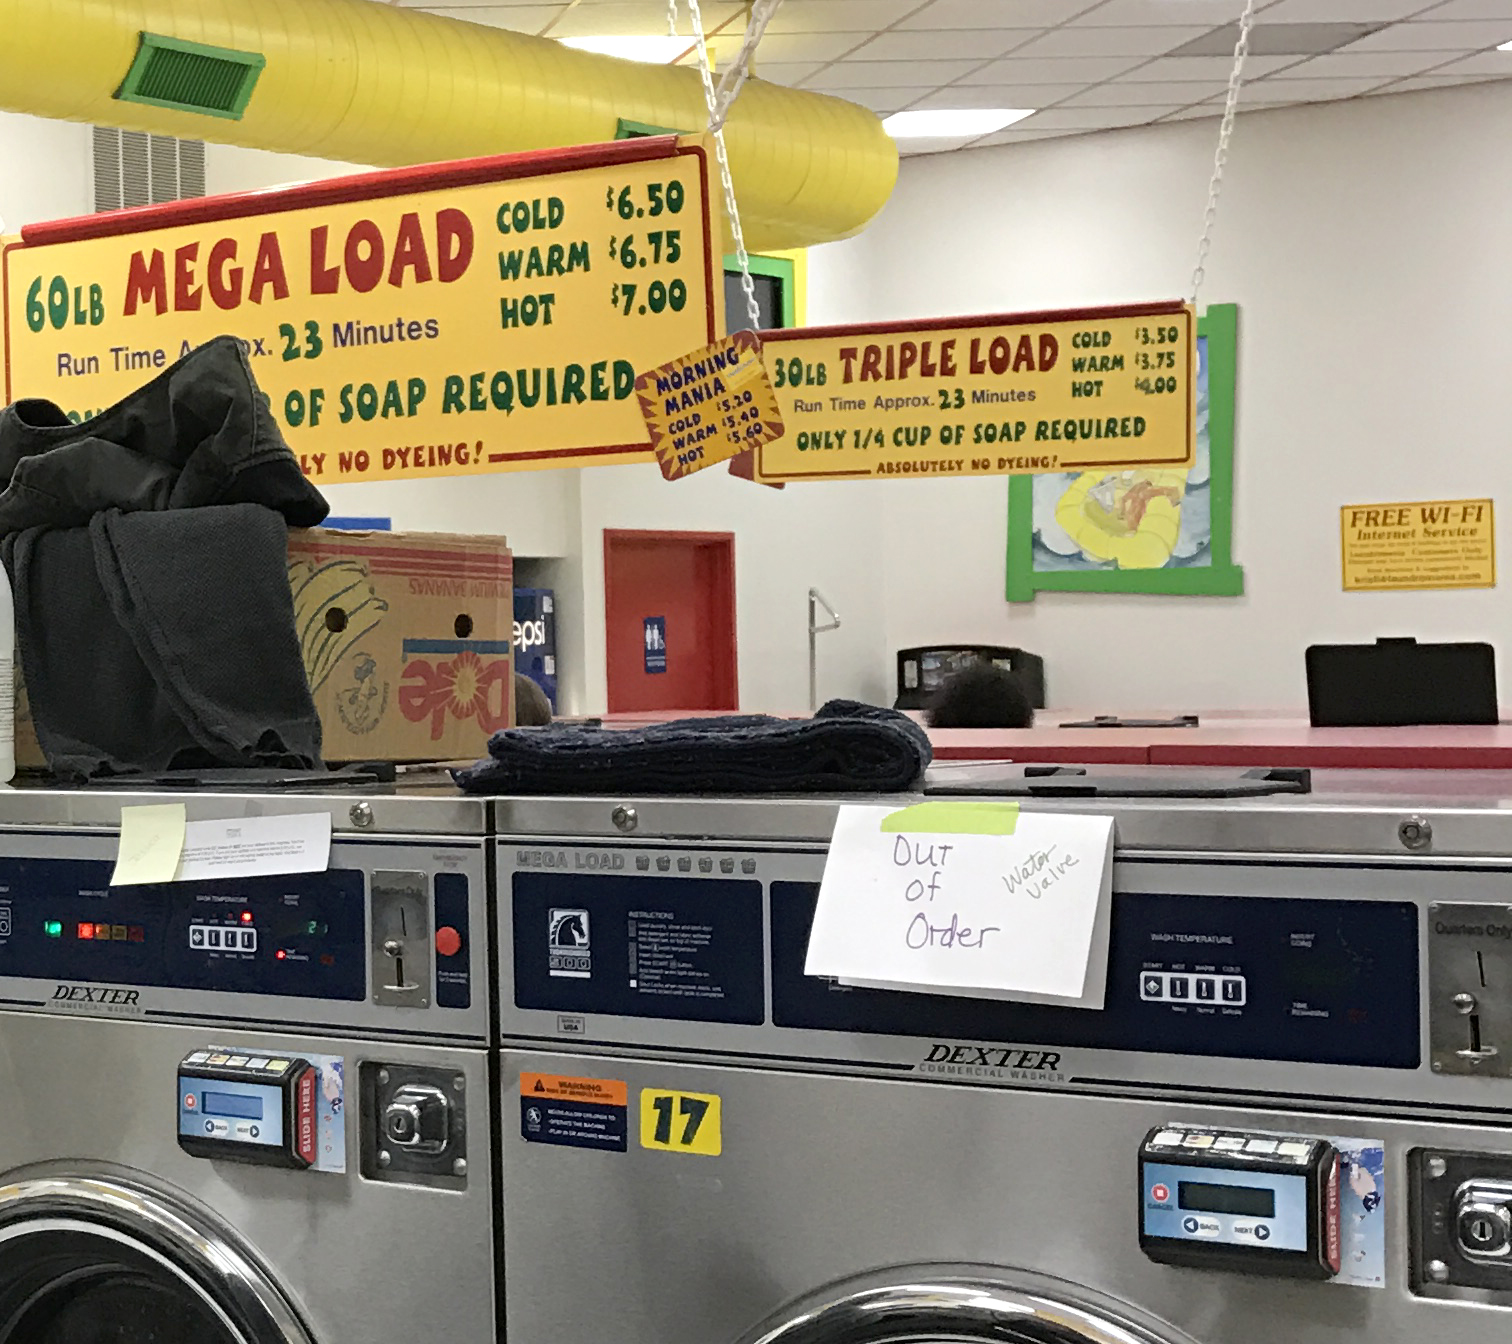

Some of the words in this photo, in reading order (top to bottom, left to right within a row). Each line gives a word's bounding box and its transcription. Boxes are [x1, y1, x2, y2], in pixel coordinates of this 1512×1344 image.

[496, 197, 565, 234] COLD
[606, 180, 685, 220] $6.50
[26, 275, 105, 333] 60LB
[123, 231, 290, 317] MEGA
[310, 207, 475, 296] LOAD
[498, 240, 591, 281] WARM
[609, 229, 682, 269] $6.75
[500, 293, 556, 329] HOT
[611, 278, 688, 316] $7.00
[57, 352, 100, 377] Run
[110, 346, 166, 372] Time
[278, 320, 324, 362] 23
[332, 317, 440, 348] Minutes
[1072, 330, 1112, 349] COLD
[1134, 326, 1178, 345] $3.50
[656, 346, 739, 398] MORNING
[774, 357, 827, 389] 30LB
[839, 338, 958, 384] TRIPLE
[969, 333, 1060, 375] LOAD
[1072, 354, 1125, 373] WARM
[1134, 351, 1176, 370] $3.75
[284, 388, 325, 427] OF
[338, 377, 427, 424] SOAP
[441, 359, 636, 417] REQUIRED
[665, 376, 727, 417] MANIA
[793, 399, 823, 413] Run
[829, 397, 866, 411] Time
[873, 395, 935, 412] Approx.
[938, 388, 965, 410] 23
[972, 388, 1037, 404] Minutes
[1072, 380, 1104, 398] HOT
[668, 412, 701, 435] COLD
[716, 390, 753, 412] $5.20
[672, 423, 718, 450] WARM
[721, 406, 759, 428] $5.40
[678, 445, 705, 466] HOT
[726, 422, 763, 444] $5.60
[796, 429, 846, 451] ONLY
[853, 427, 886, 450] 1/4
[893, 425, 932, 447] CUP
[940, 424, 966, 446] OF
[973, 421, 1027, 444] SOAP
[1035, 416, 1147, 444] REQUIRED
[338, 449, 371, 472] NO
[382, 440, 484, 472] DYEING!
[876, 459, 964, 475] ABSOLUTELY
[971, 458, 991, 471] NO
[998, 455, 1059, 471] DYEING!
[1351, 508, 1412, 528] FREE
[1420, 505, 1484, 525] WI-FI
[1357, 529, 1416, 541] Internet
[1422, 527, 1478, 538] Service
[512, 614, 546, 652] epsi
[516, 850, 568, 869] MEGA
[574, 852, 626, 871] LOAD
[1002, 844, 1058, 894] Water
[905, 912, 1000, 949] Order
[1435, 921, 1484, 936] Quarters
[51, 984, 140, 1006] DEXTER
[919, 1063, 1004, 1078] COMMERCIAL
[1010, 1070, 1065, 1082] WASHER
[924, 1044, 1061, 1071] DEXTER
[302, 1079, 311, 1113] HERE
[302, 1115, 311, 1153] SLIDE
[653, 1095, 710, 1146] 17
